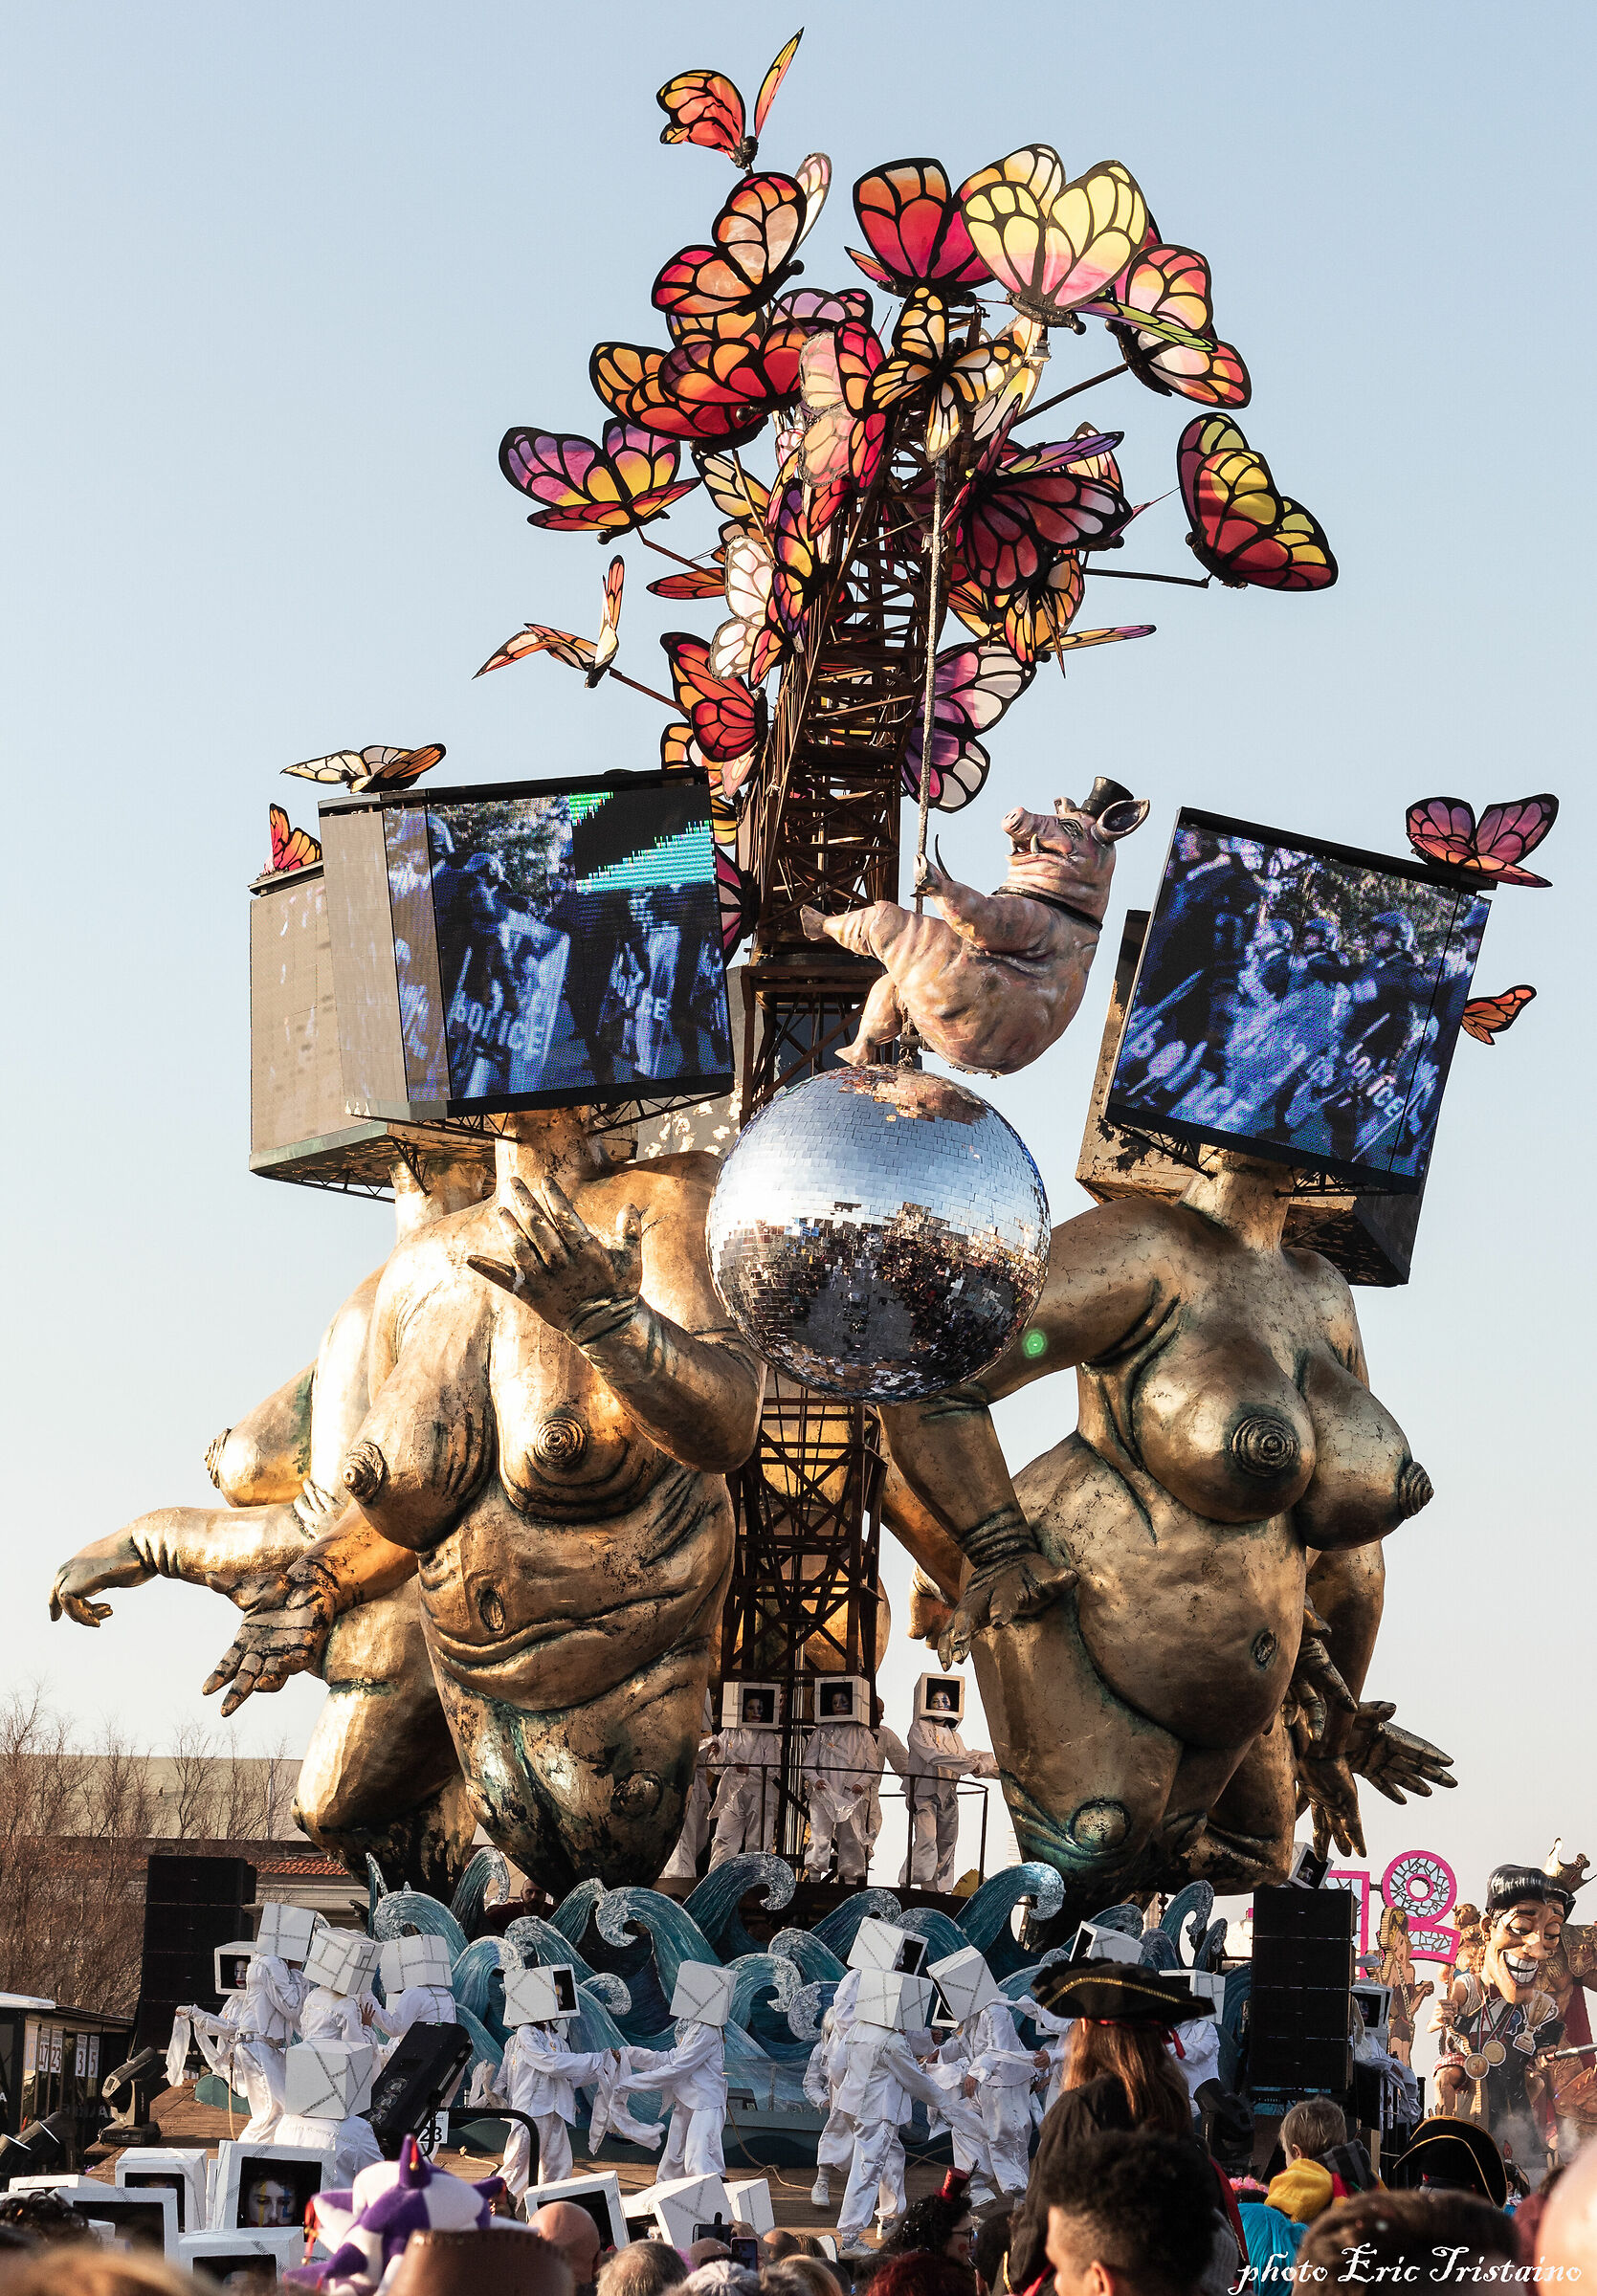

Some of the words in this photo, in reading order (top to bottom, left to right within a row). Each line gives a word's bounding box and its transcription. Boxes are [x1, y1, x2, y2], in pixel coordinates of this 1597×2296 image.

[38, 2043, 48, 2068] 17
[51, 2045, 61, 2070] 23
[78, 2050, 83, 2074] 3
[90, 2051, 97, 2075] 5
[419, 2126, 442, 2143] 23
